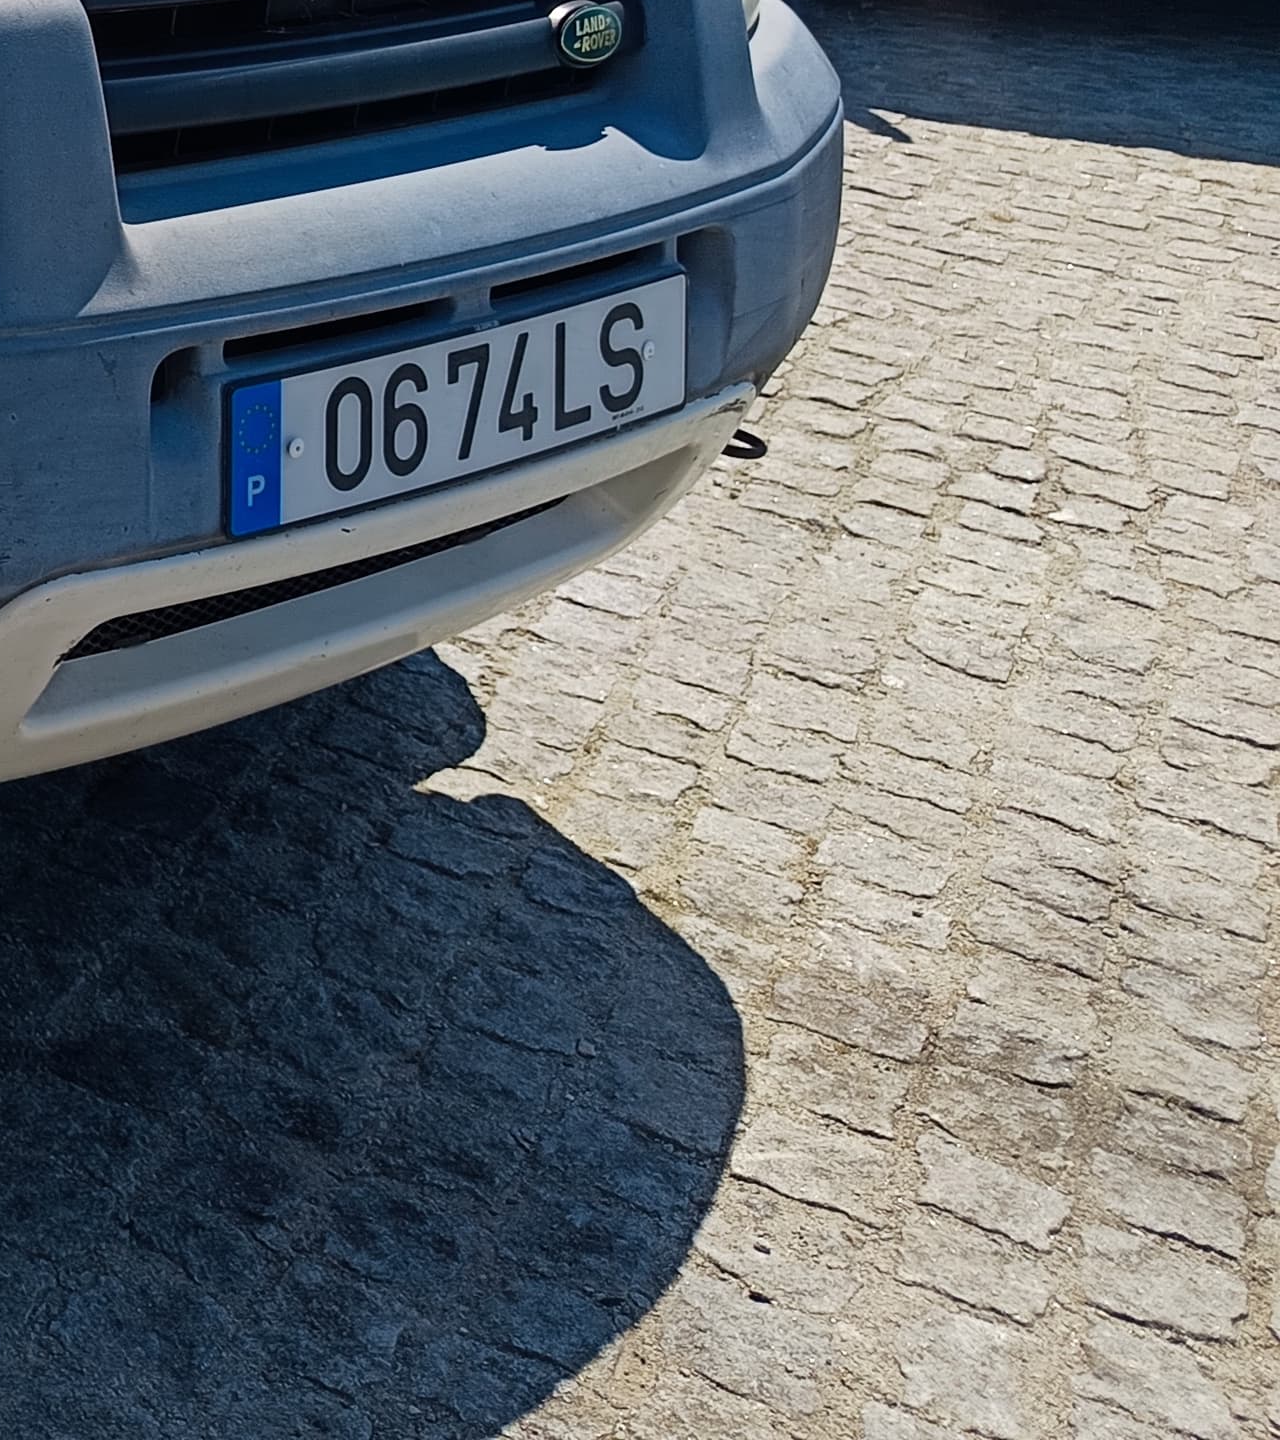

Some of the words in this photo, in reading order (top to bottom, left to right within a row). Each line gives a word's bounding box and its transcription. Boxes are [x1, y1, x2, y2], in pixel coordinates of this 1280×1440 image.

[575, 14, 605, 37] LAND
[581, 29, 616, 53] ROVER
[247, 474, 266, 507] P
